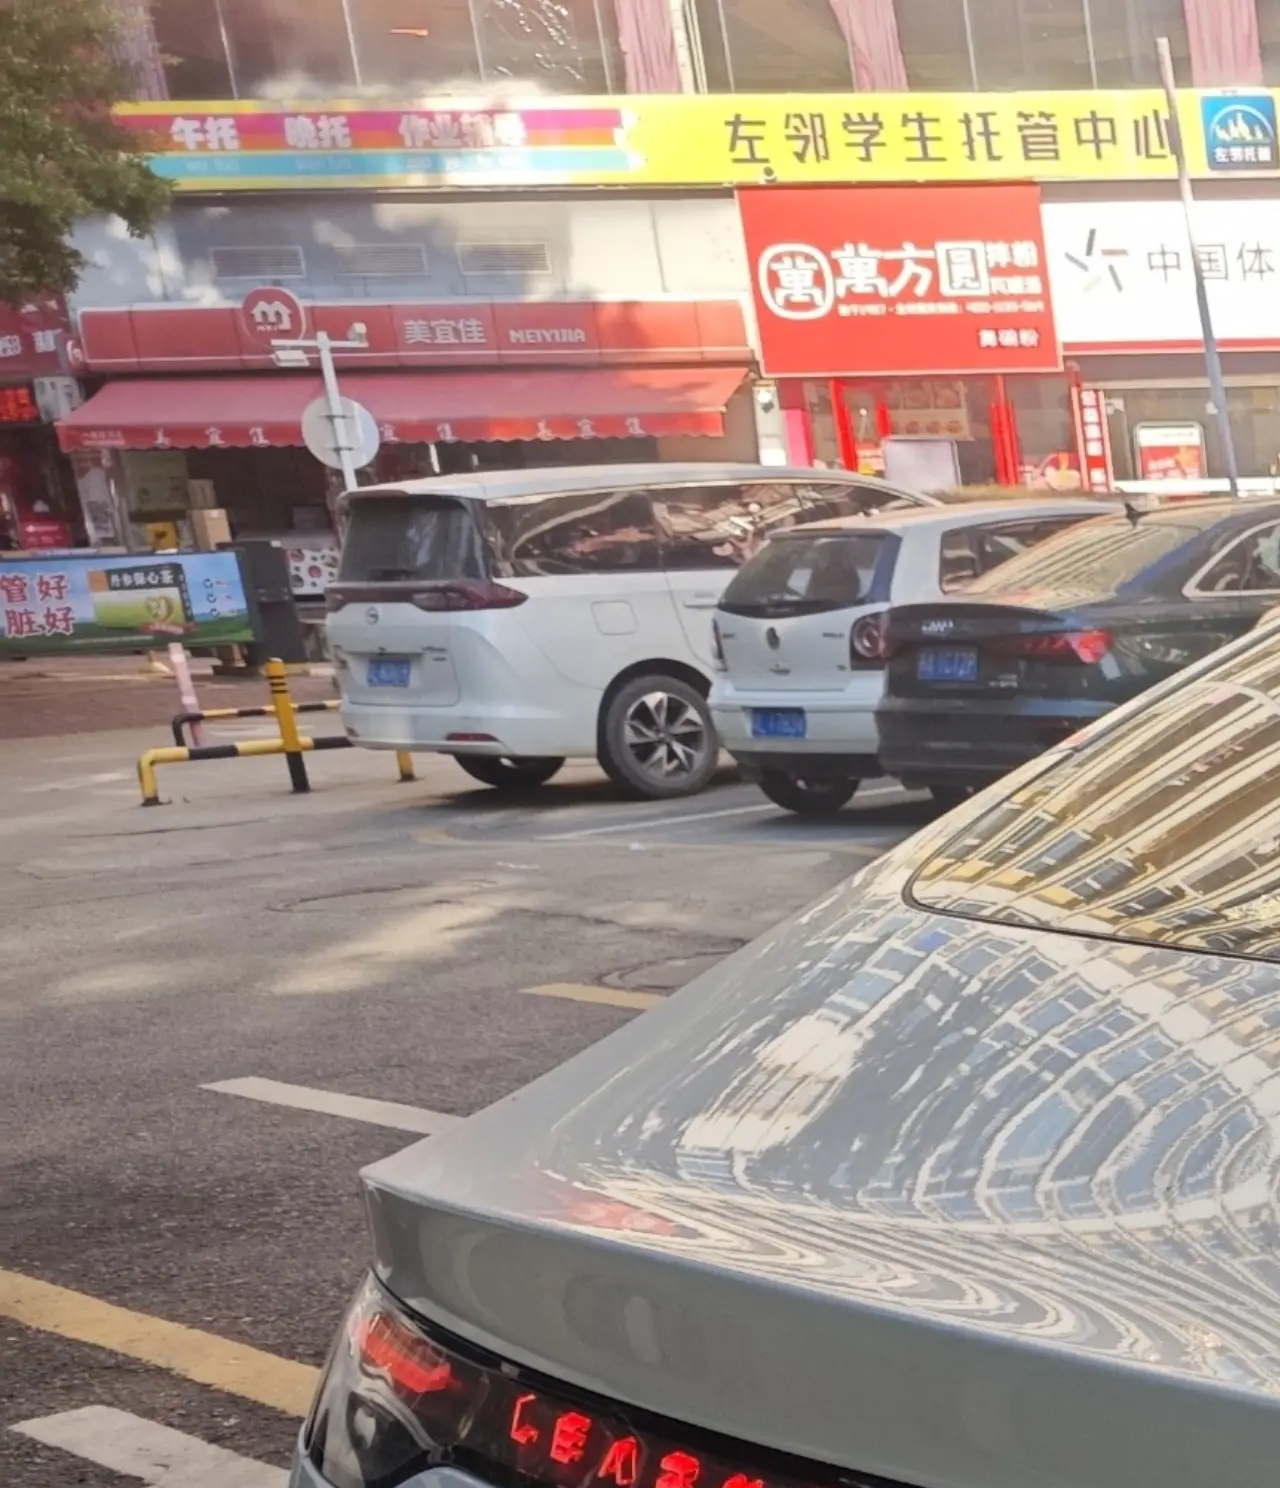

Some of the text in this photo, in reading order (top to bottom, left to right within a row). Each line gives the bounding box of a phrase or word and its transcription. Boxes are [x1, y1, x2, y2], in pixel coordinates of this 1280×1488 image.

[170, 115, 241, 152] 午托
[724, 108, 1182, 164] 左邻学生托管中心
[403, 318, 487, 345] 美宜佳
[509, 328, 586, 344] MEIYIJIA
